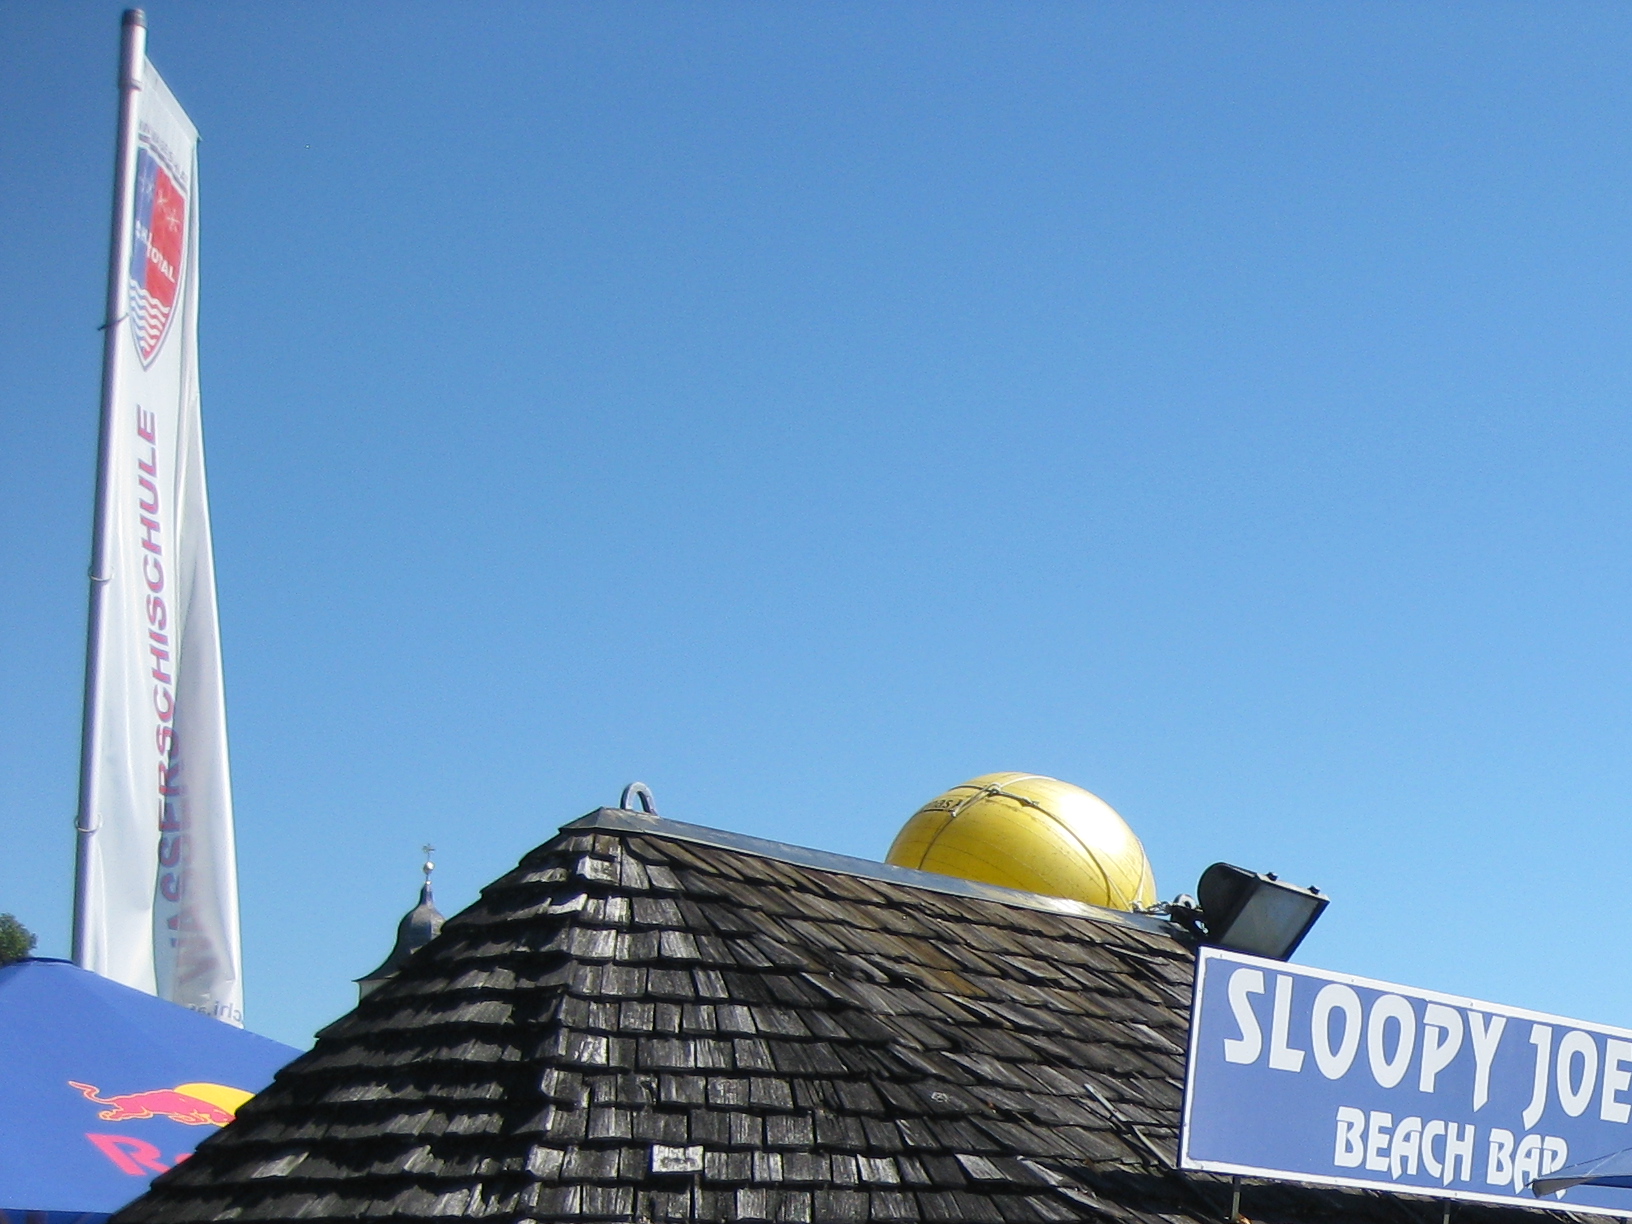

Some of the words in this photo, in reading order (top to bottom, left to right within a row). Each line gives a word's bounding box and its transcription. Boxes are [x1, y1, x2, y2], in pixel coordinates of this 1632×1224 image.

[1223, 967, 1507, 1113] SLOOPY
[1333, 1105, 1476, 1188] BEACH
[1486, 1127, 1568, 1200] BAR
